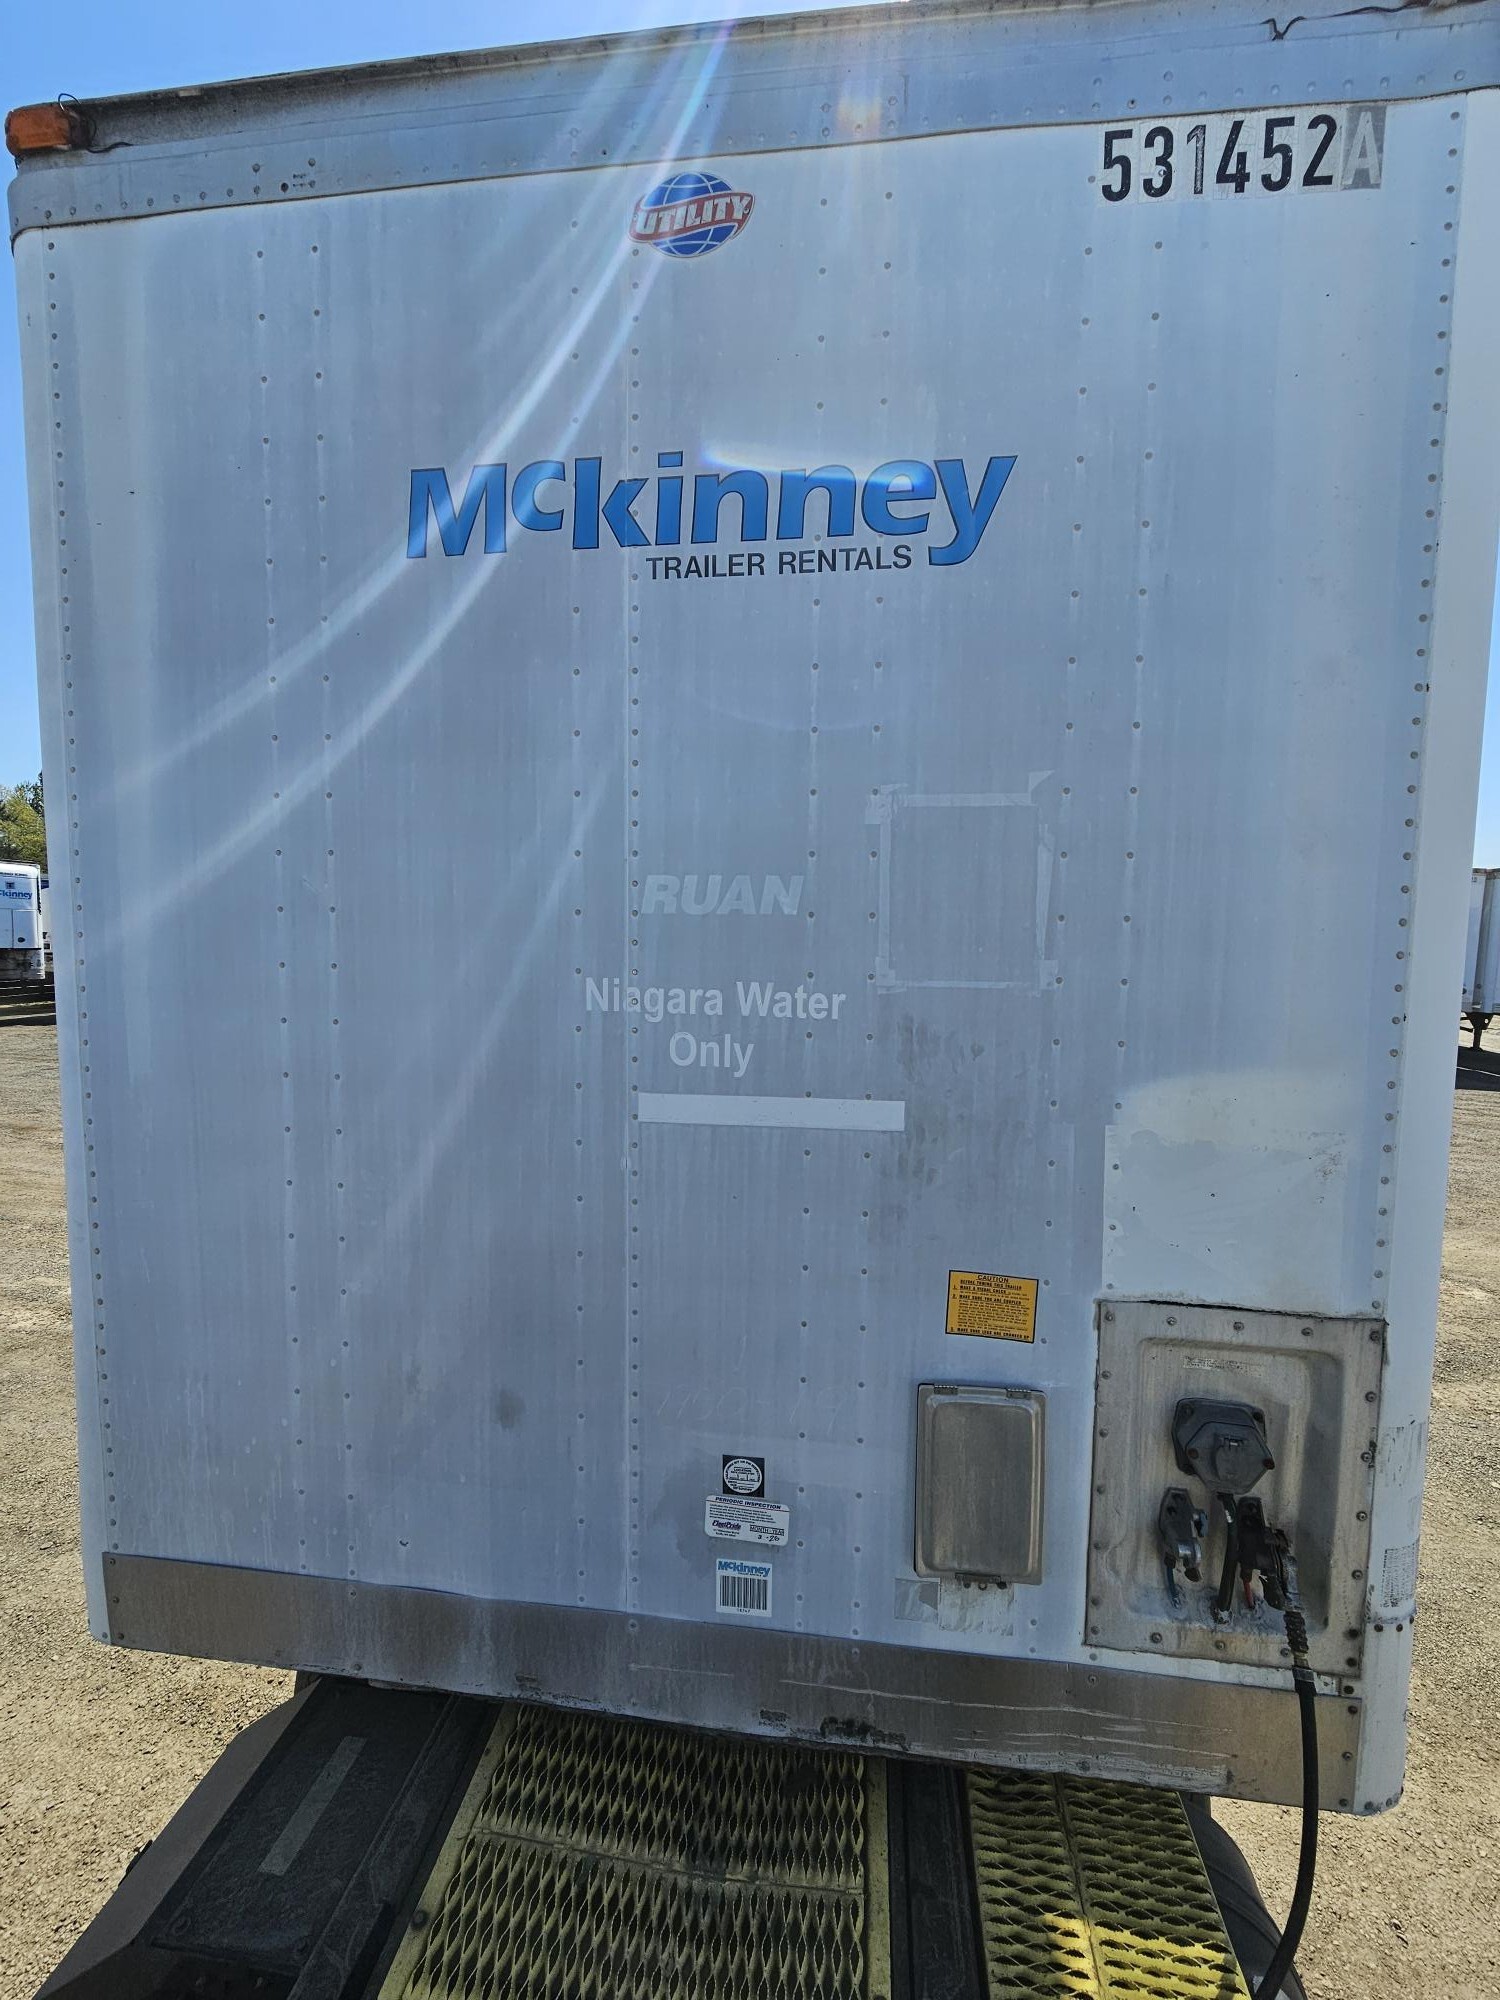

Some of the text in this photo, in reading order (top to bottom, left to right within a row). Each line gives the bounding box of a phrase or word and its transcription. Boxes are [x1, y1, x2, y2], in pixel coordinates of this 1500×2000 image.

[635, 195, 751, 235] UTILITY
[646, 544, 913, 580] TRAILER RENTALS
[641, 874, 804, 916] RUAN
[585, 977, 847, 1023] Niagara Water
[669, 1032, 755, 1078] Only
[977, 1274, 1009, 1283] CAUTION
[715, 1496, 782, 1510] PERIODIC INSPECTION
